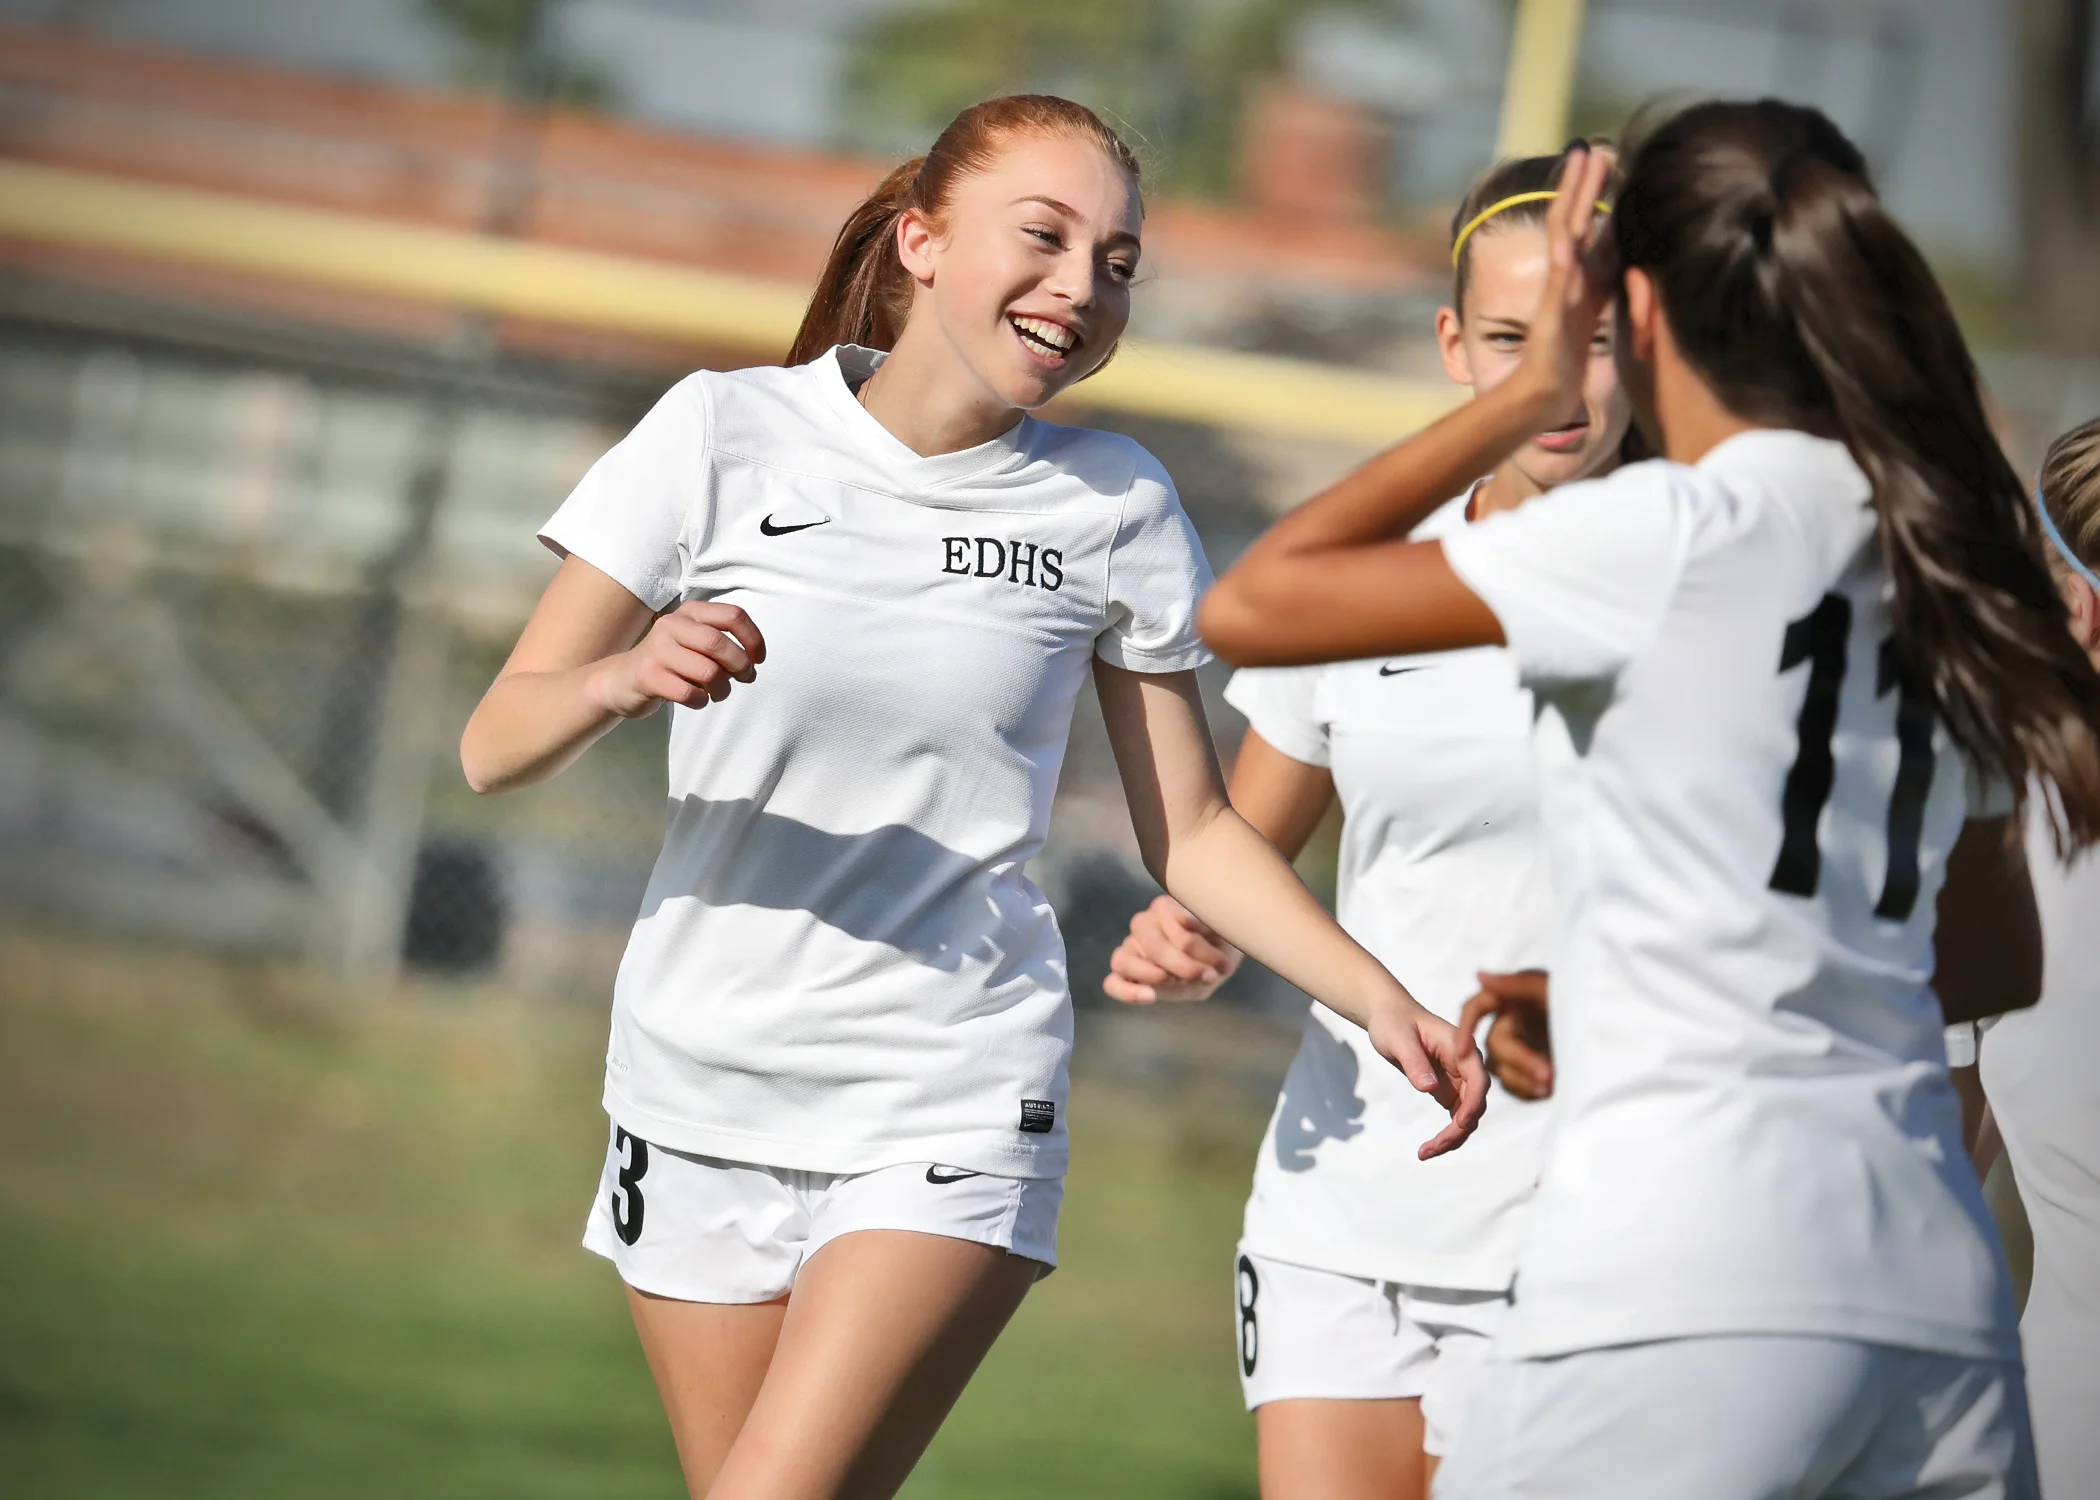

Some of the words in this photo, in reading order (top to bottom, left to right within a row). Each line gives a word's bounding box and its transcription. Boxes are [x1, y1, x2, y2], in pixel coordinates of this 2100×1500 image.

[942, 537, 1064, 591] EDHS
[1767, 590, 1936, 923] 11
[611, 1124, 649, 1247] 3
[1238, 1254, 1259, 1378] 8
